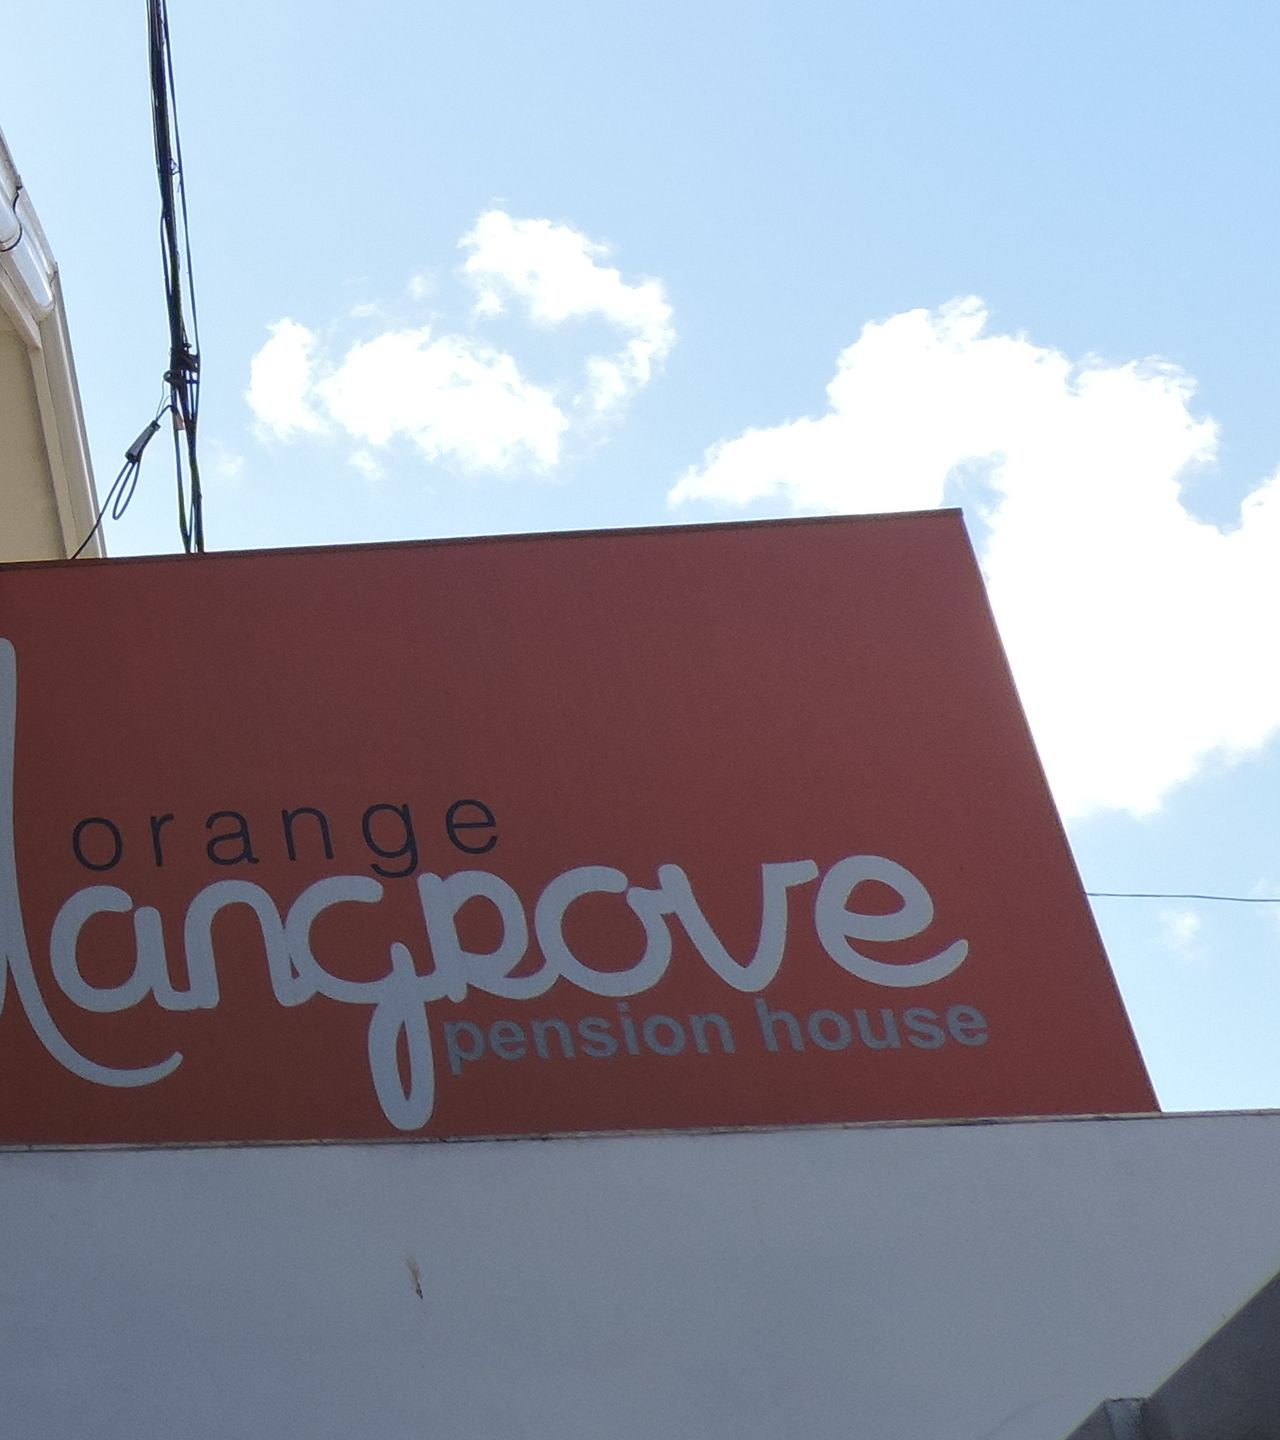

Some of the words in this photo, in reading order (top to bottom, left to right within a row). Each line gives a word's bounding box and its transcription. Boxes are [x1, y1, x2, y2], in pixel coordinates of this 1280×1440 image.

[72, 798, 498, 878] orange
[443, 1001, 737, 1075] pension
[754, 997, 989, 1052] house
